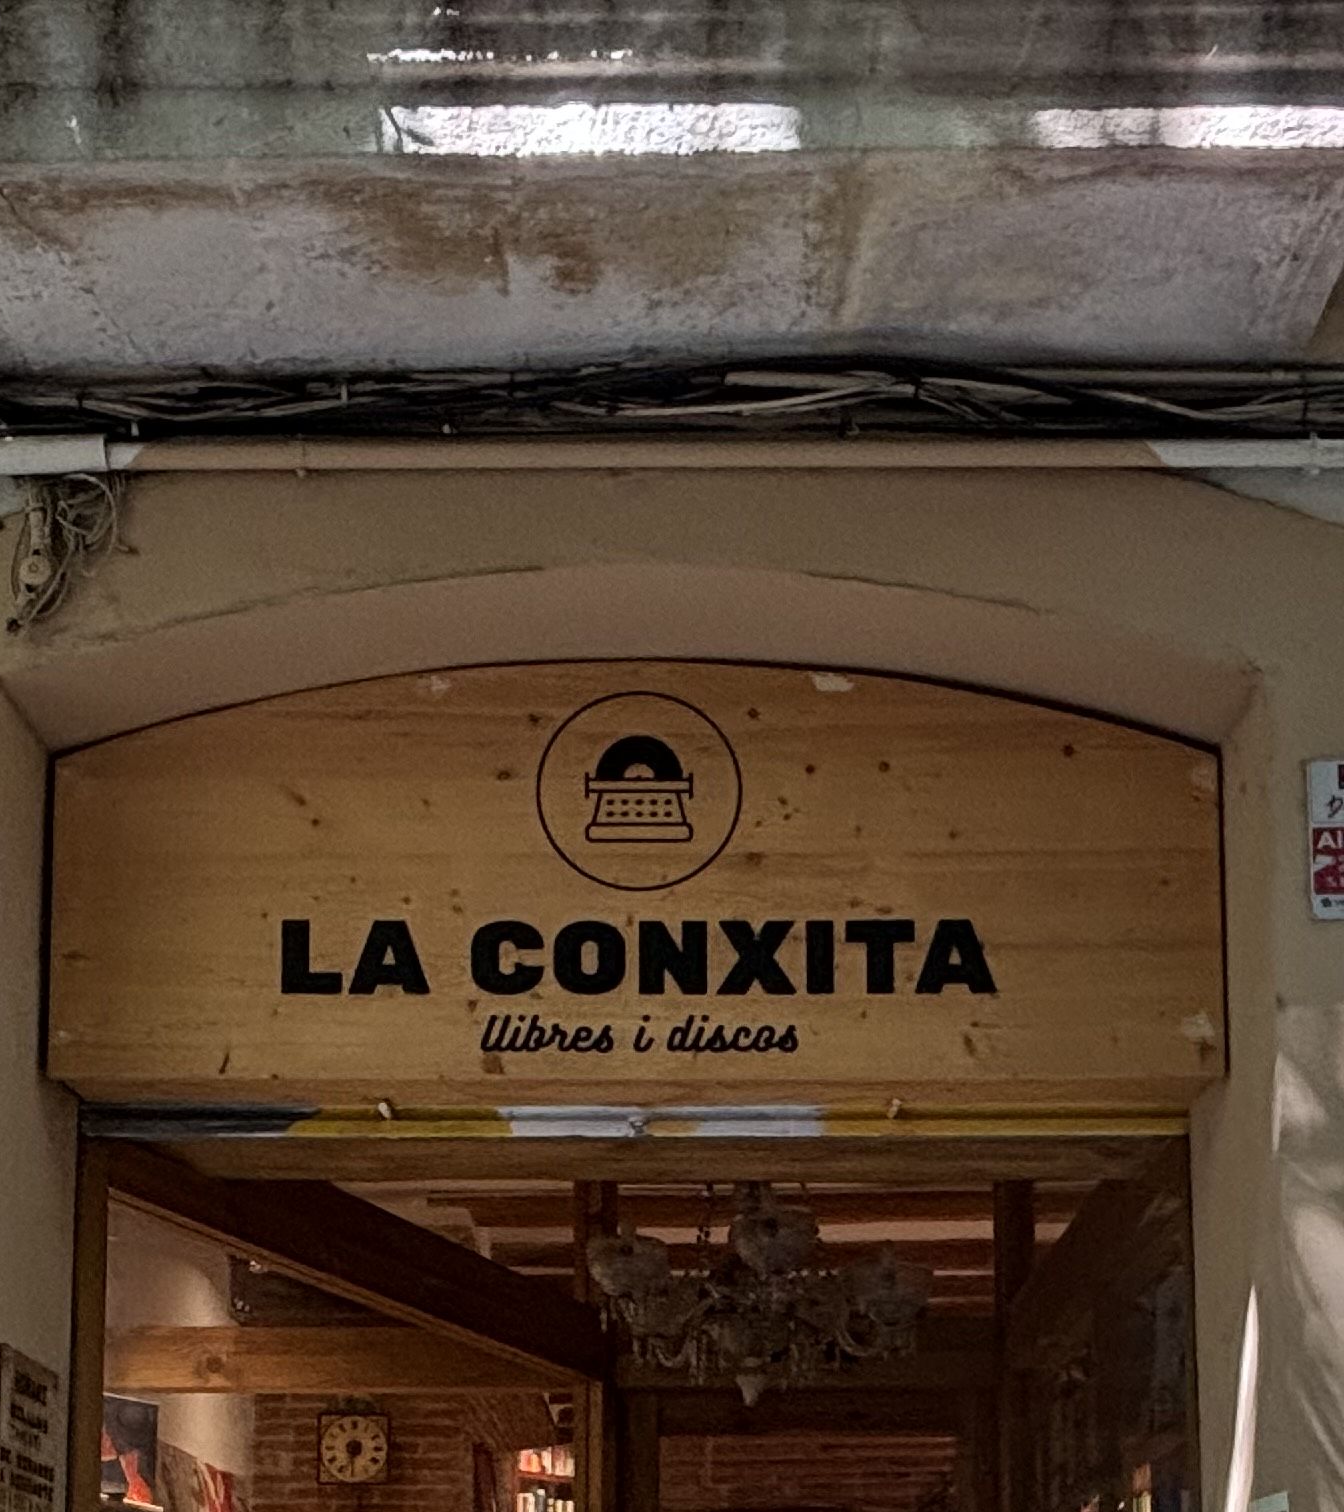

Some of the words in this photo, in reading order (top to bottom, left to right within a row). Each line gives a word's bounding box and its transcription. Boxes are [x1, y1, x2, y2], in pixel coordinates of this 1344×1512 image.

[280, 918, 430, 996] LA
[470, 918, 998, 996] CONXITA
[480, 1014, 614, 1054] llibres
[632, 1014, 655, 1053] i
[666, 1014, 799, 1054] discos
